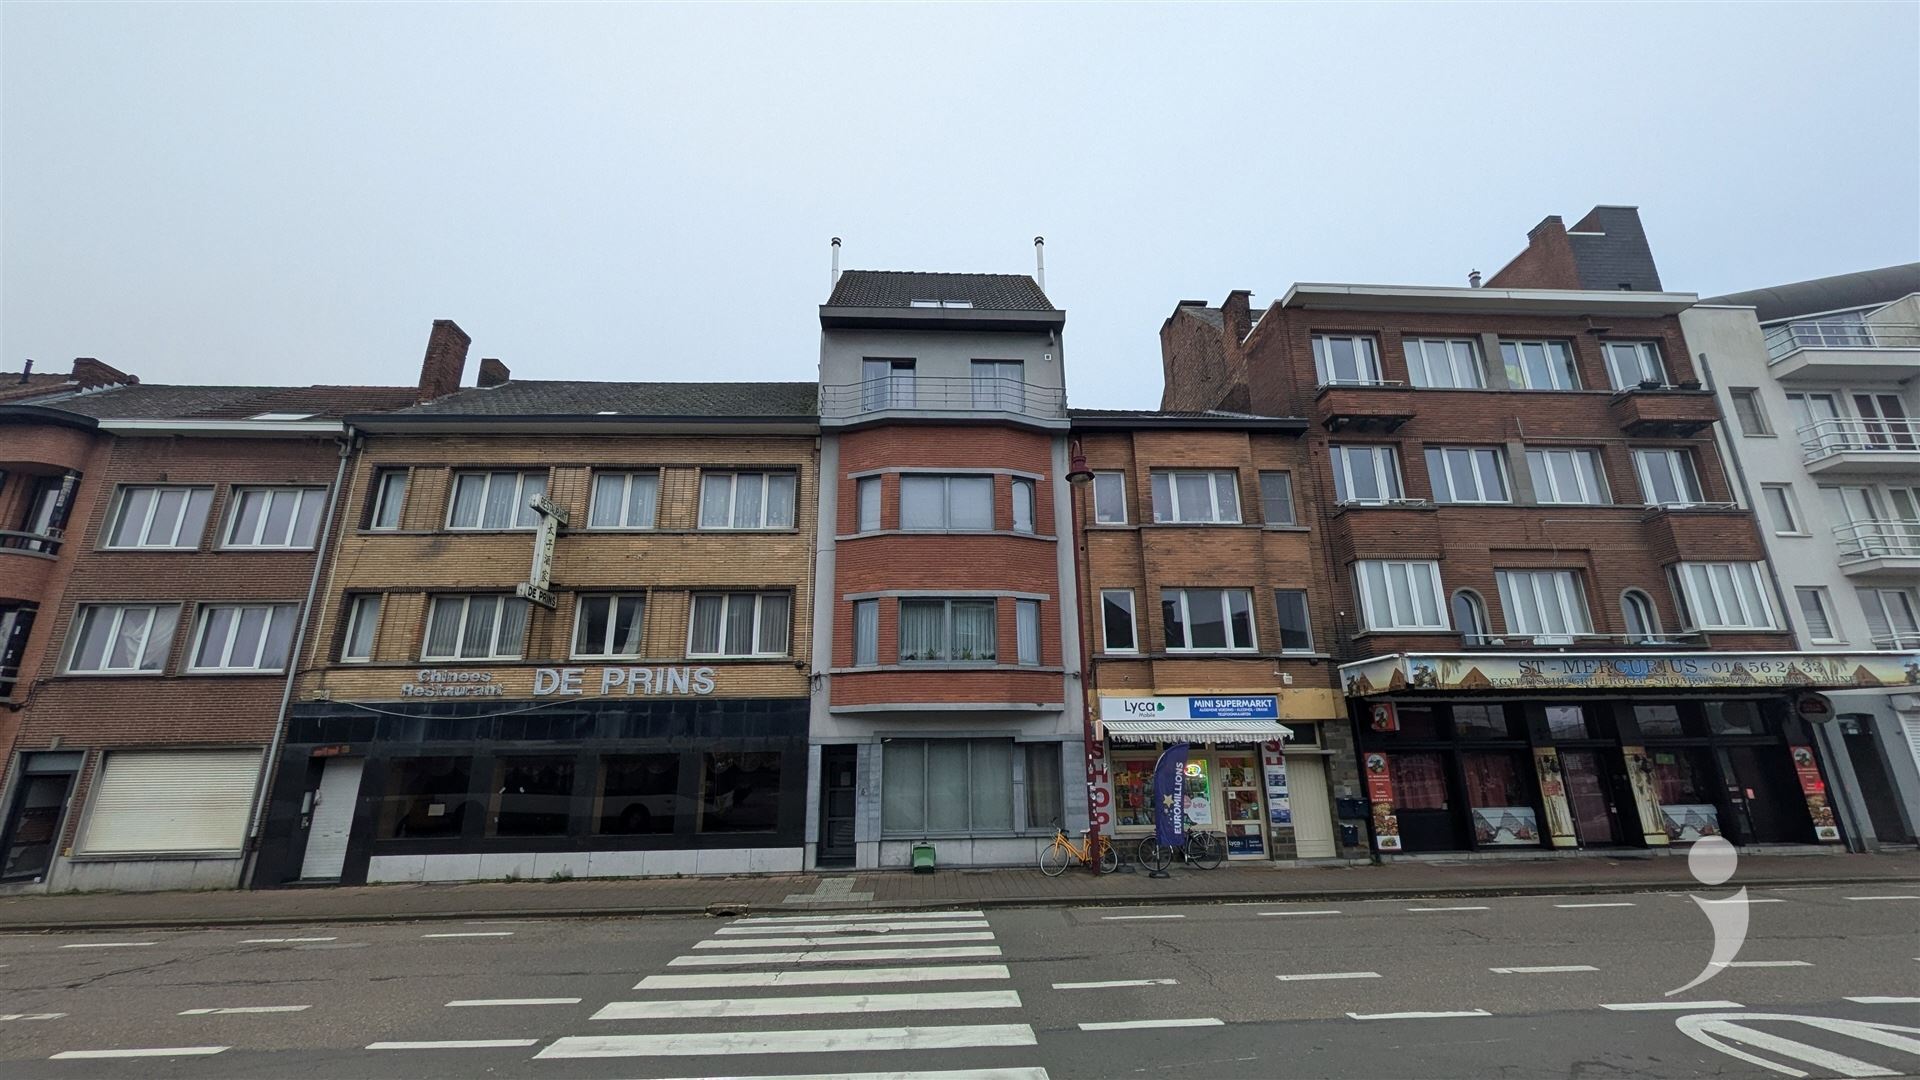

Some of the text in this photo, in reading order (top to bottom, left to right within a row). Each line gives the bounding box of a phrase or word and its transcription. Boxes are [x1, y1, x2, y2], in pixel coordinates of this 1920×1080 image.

[527, 586, 556, 608] DE PRINS
[1518, 660, 1545, 675] ST
[1563, 659, 1698, 675] MERCURIUS
[1711, 662, 1744, 674] 016
[1749, 662, 1771, 673] 56
[1775, 662, 1797, 673] 24
[1802, 662, 1824, 673] 33
[417, 669, 492, 683] Chinees
[533, 666, 716, 696] DE PRINS
[400, 682, 504, 697] Restaurant
[1124, 700, 1155, 714] Lyca
[1194, 699, 1272, 708] MINI SUPERMARKT
[1174, 762, 1184, 835] EUROMILLIONS
